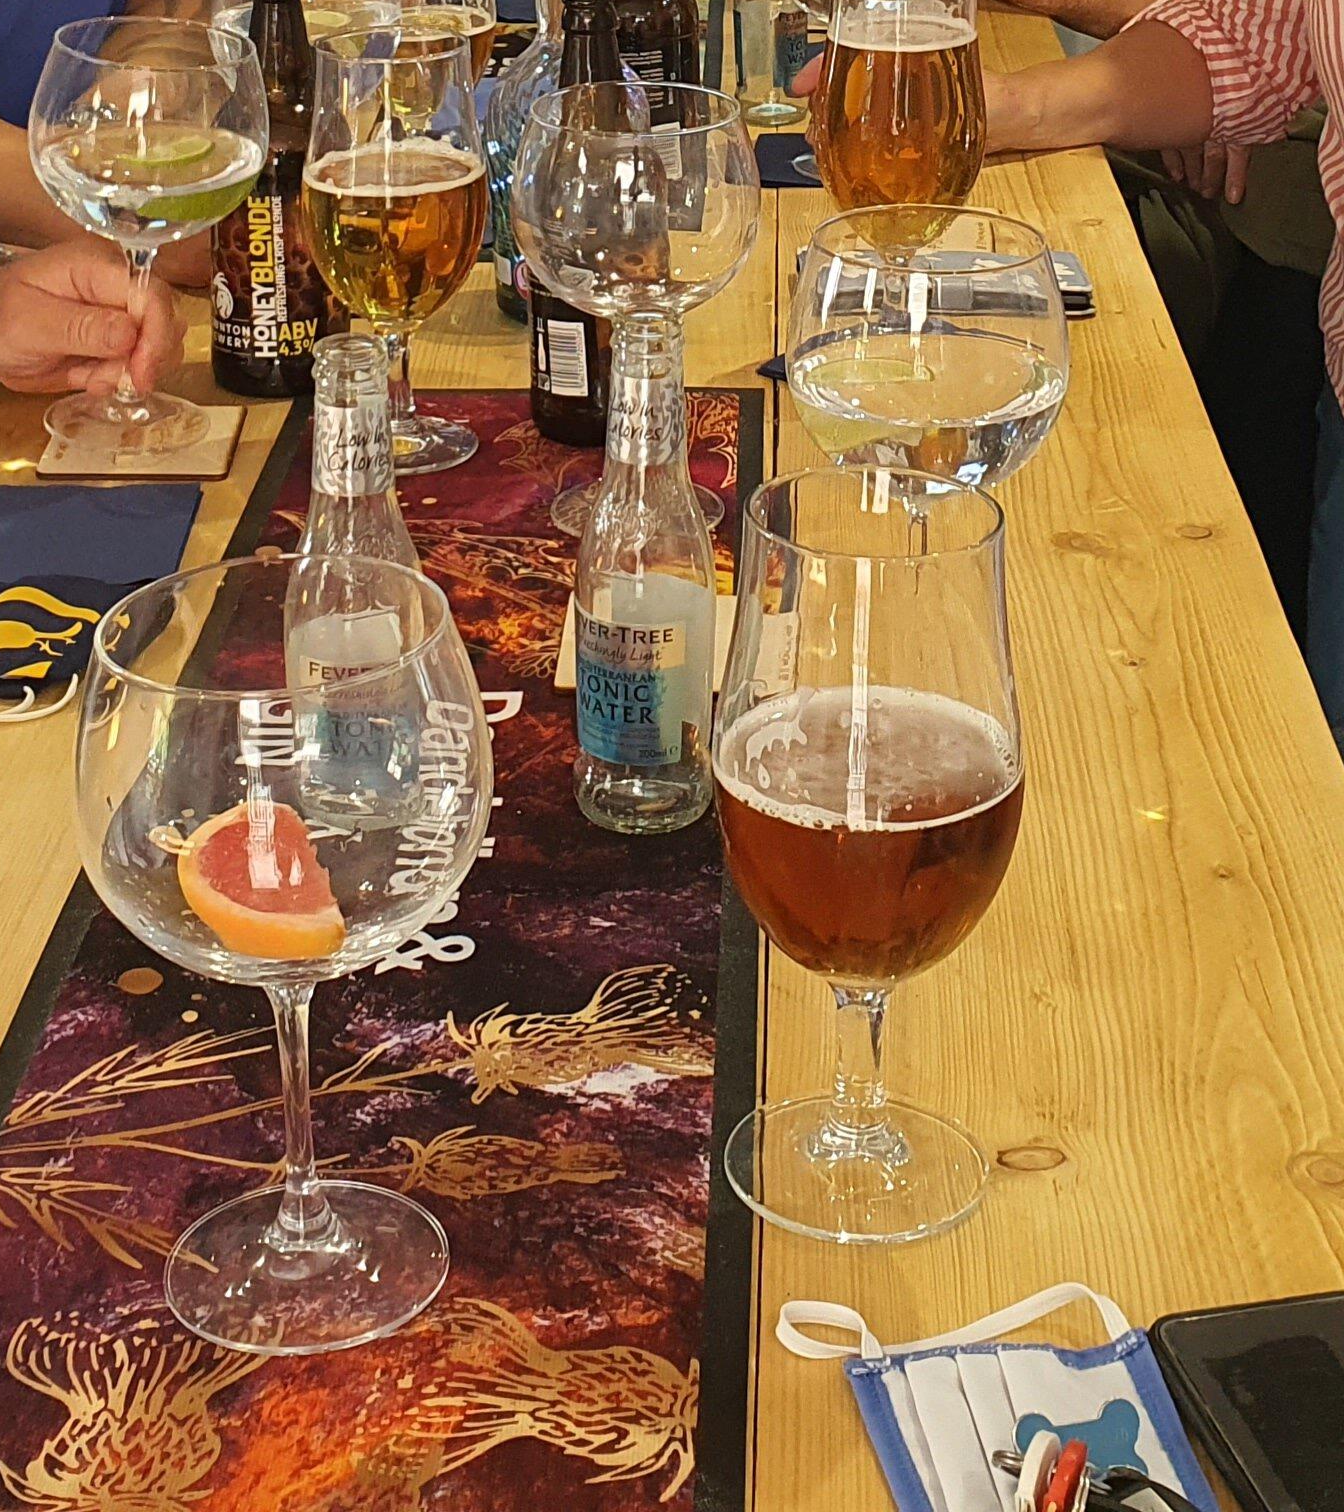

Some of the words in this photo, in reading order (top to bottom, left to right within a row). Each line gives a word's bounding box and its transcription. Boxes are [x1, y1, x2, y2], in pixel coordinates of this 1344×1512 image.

[271, 195, 284, 234] BLONDE
[273, 235, 286, 263] CRISP
[275, 262, 288, 323] REFRESHING
[278, 317, 319, 341] ABV
[336, 428, 370, 448] Low
[610, 417, 663, 442] alories
[579, 617, 674, 645] VER-TREE
[629, 647, 663, 665] Light
[579, 666, 650, 703] TONIC
[579, 690, 655, 725] WATER
[374, 930, 476, 976] &
